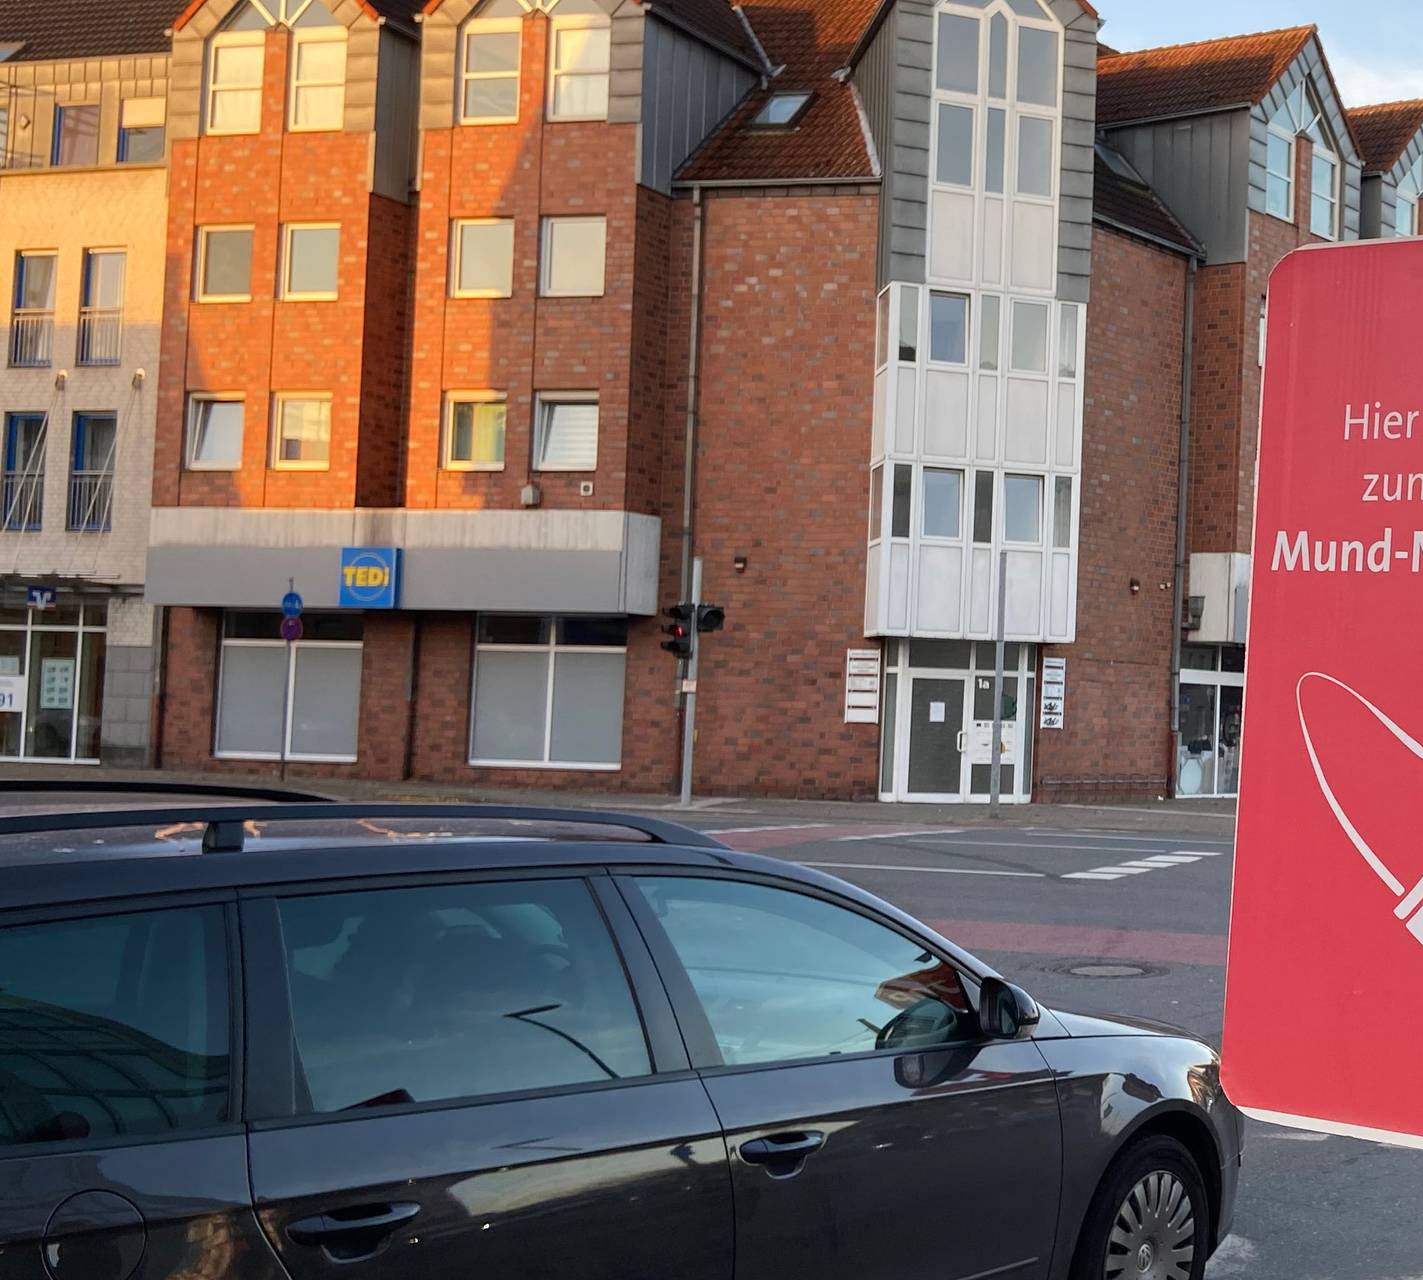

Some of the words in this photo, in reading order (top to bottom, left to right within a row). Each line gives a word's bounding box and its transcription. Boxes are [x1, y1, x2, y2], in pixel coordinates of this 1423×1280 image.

[1344, 403, 1420, 441] Hier
[343, 566, 389, 587] TEDi
[977, 678, 990, 689] 1a
